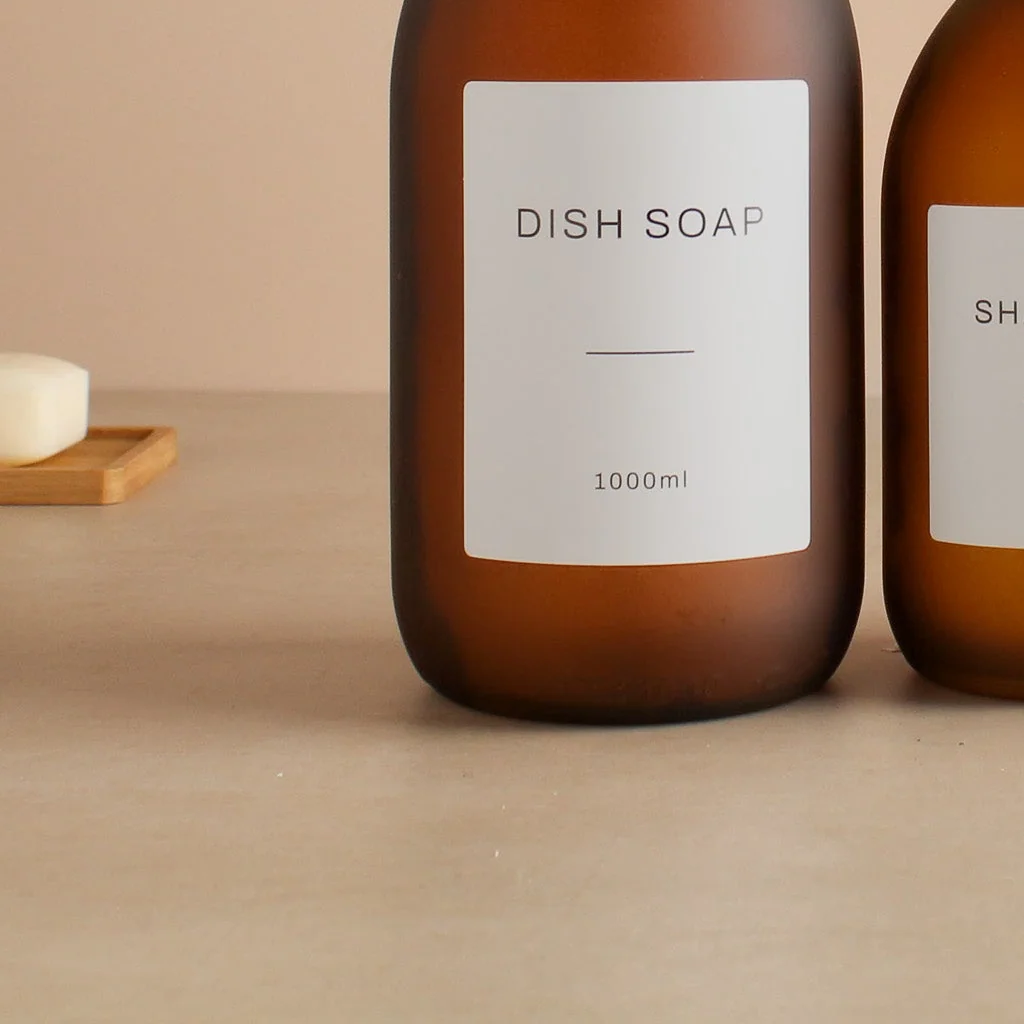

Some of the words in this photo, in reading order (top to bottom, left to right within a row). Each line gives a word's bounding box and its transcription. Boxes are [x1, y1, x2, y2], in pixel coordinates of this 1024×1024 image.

[517, 207, 622, 240] DISH
[645, 206, 765, 240] SOAP
[594, 469, 687, 491] 1000ml
